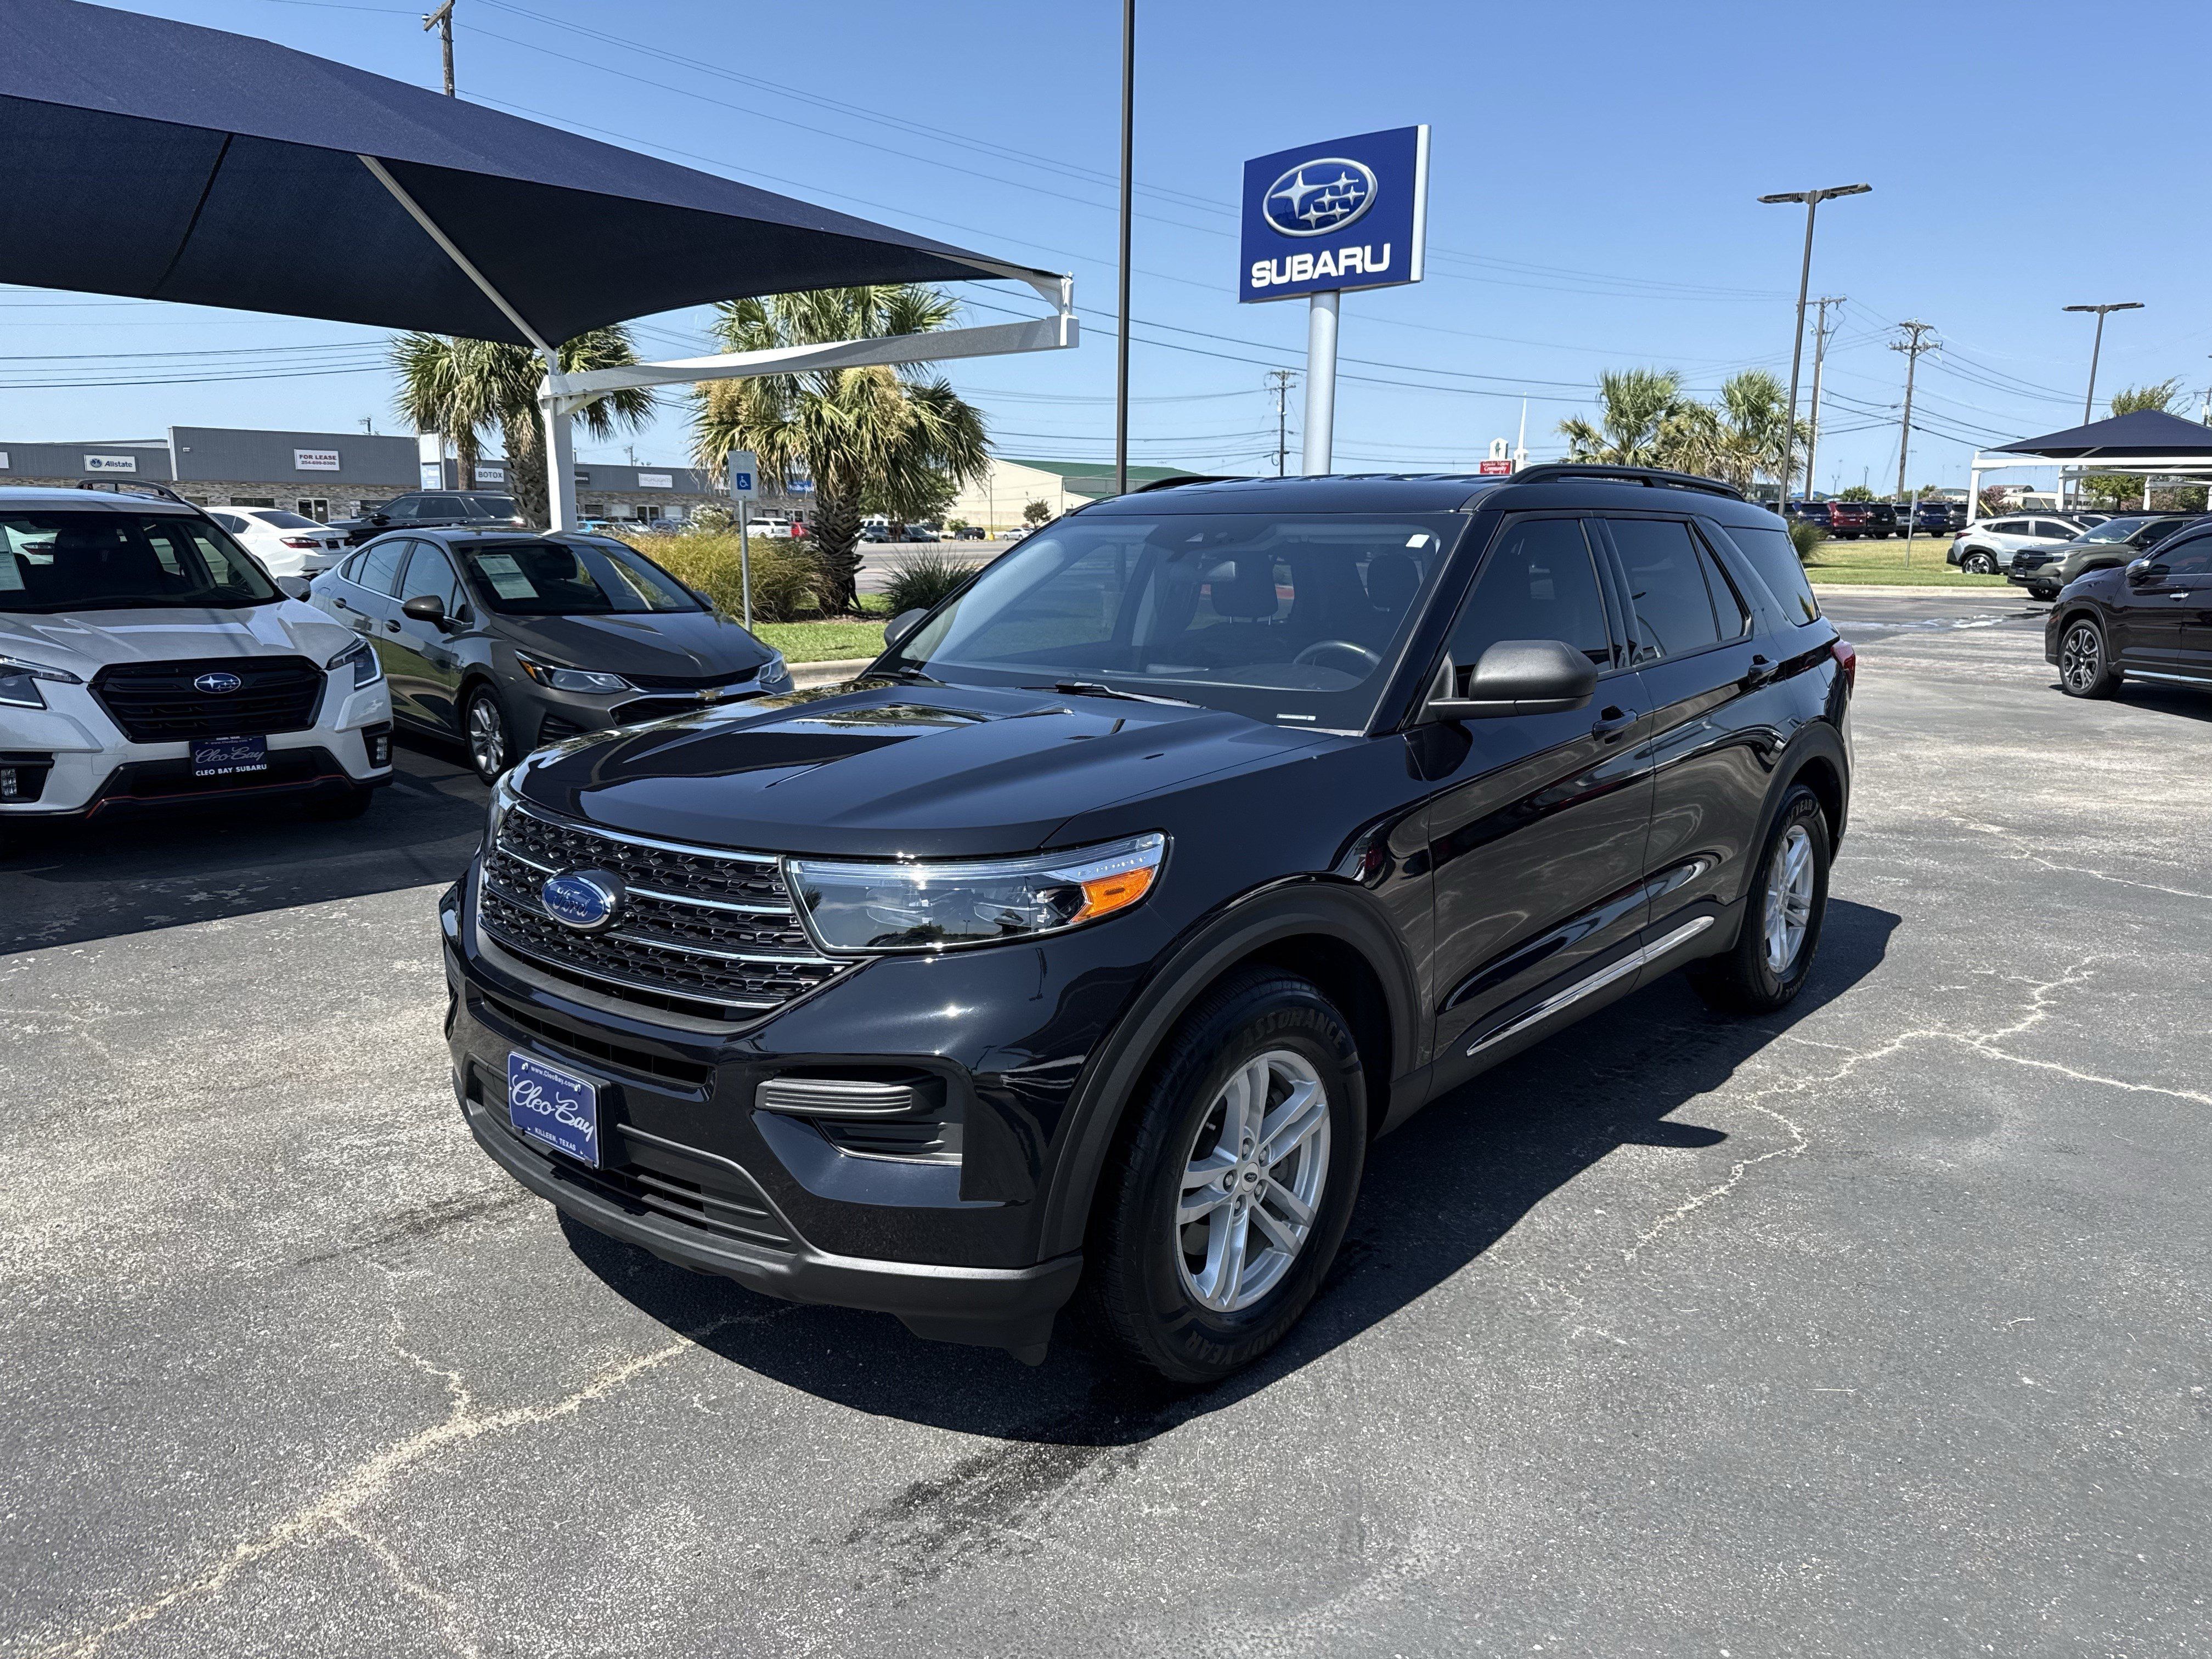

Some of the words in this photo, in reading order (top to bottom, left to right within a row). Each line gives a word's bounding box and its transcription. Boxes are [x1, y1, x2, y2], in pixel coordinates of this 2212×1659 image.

[1251, 242, 1391, 287] SUBARU
[195, 748, 230, 763] Cleo
[230, 747, 264, 761] Bay
[552, 885, 591, 917] Ford
[1242, 1007, 1346, 1052] ASSURANCE
[531, 1066, 577, 1089] www.CleoBay.com
[512, 1075, 555, 1115] Cleo
[555, 1091, 594, 1142] Bay
[535, 1127, 558, 1144] KILLEEN,
[559, 1137, 576, 1151] TEXAS
